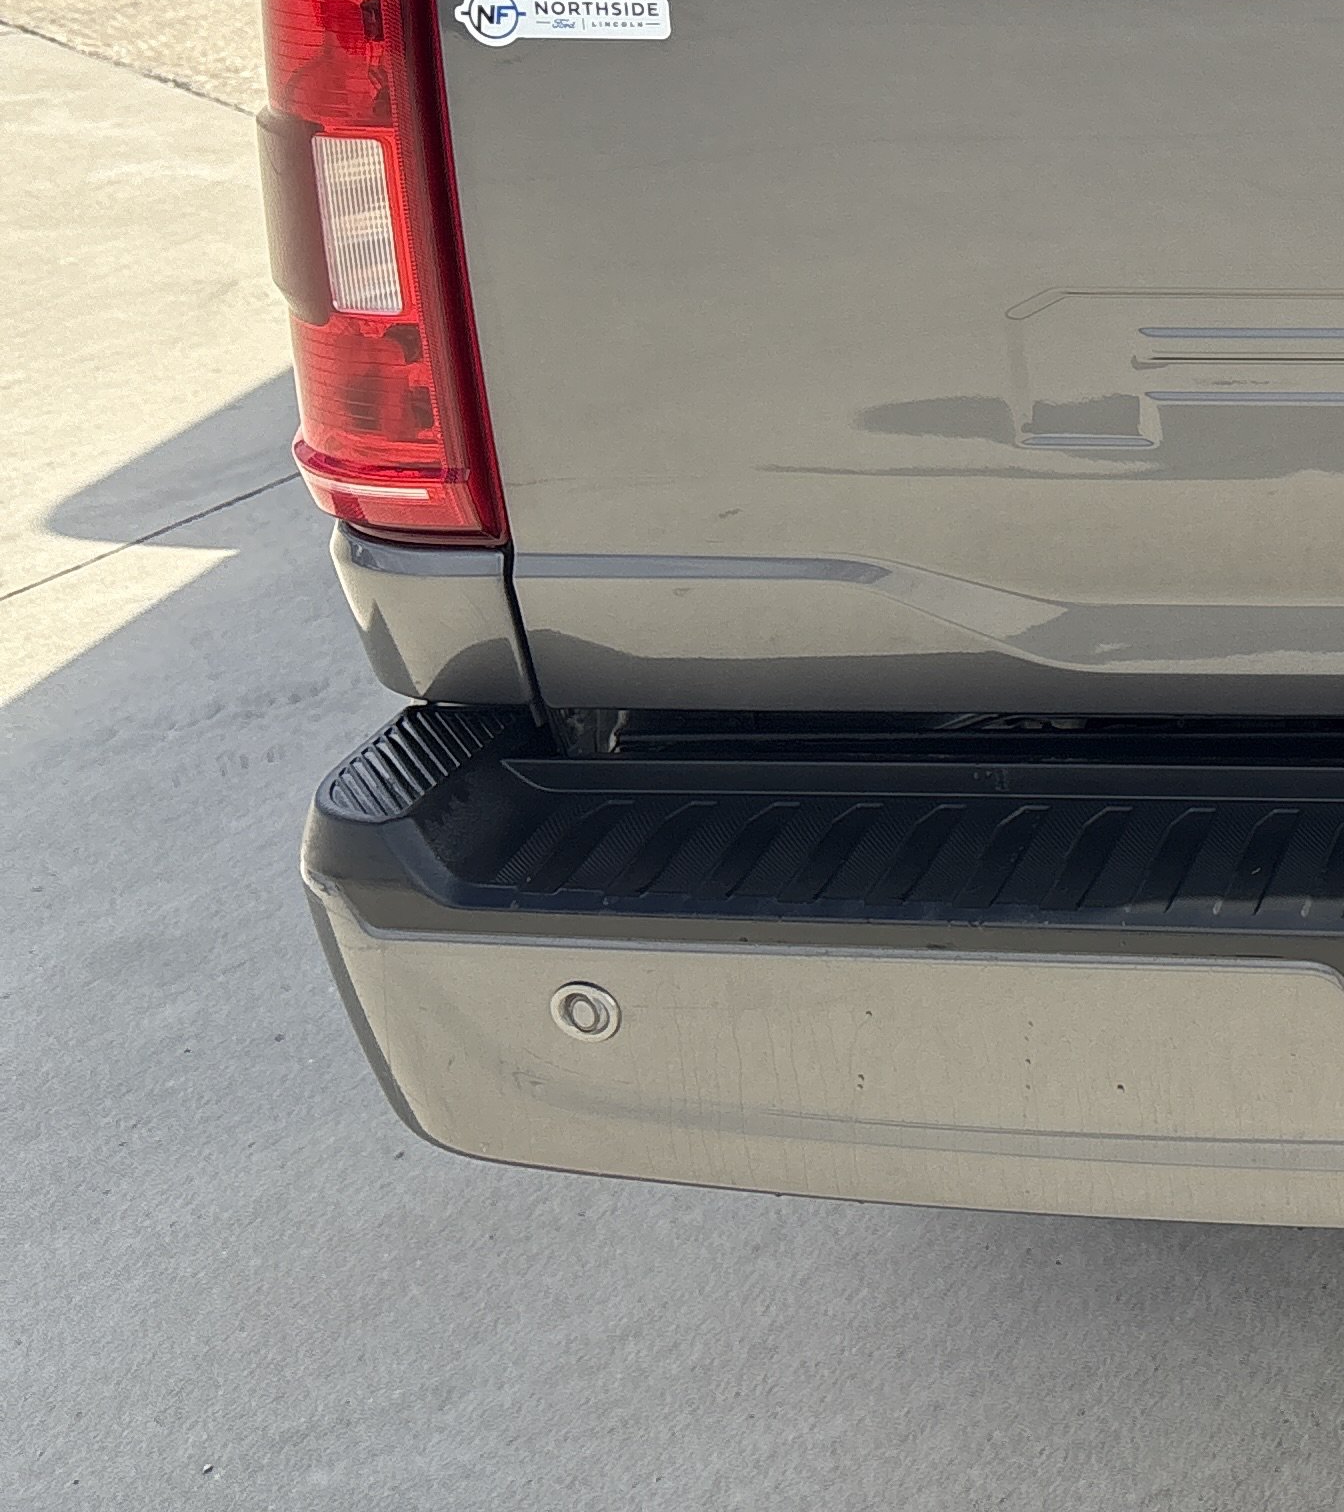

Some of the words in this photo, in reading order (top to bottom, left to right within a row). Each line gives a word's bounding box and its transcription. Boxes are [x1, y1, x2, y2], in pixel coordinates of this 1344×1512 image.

[534, 0, 660, 17] NORTHSIDE
[551, 18, 577, 30] Ford
[591, 21, 644, 29] LINCOLN
